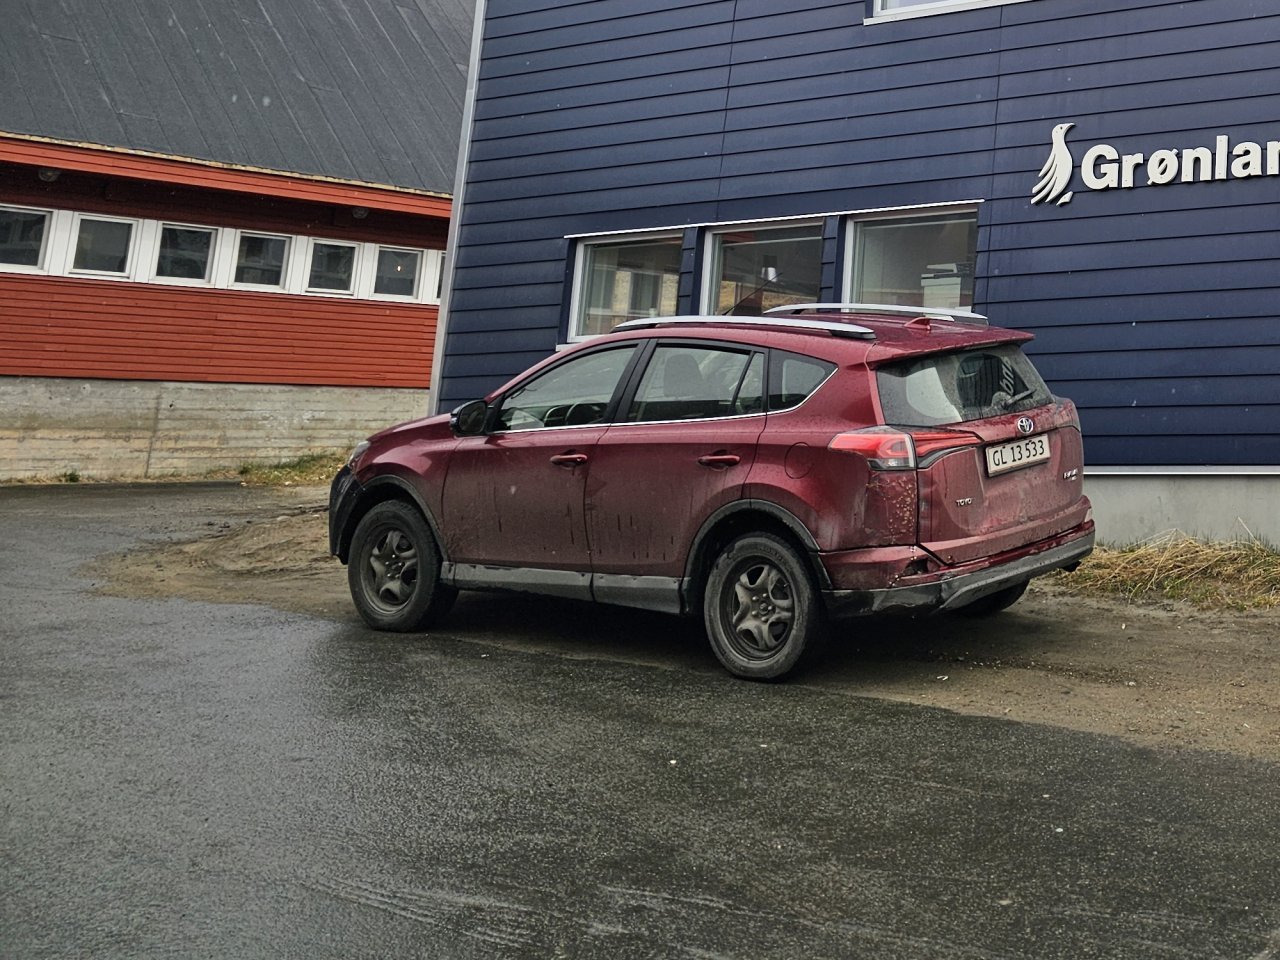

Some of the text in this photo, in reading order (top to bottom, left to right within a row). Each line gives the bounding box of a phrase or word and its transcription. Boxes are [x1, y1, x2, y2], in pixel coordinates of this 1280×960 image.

[992, 440, 1045, 466] GL 13 533
